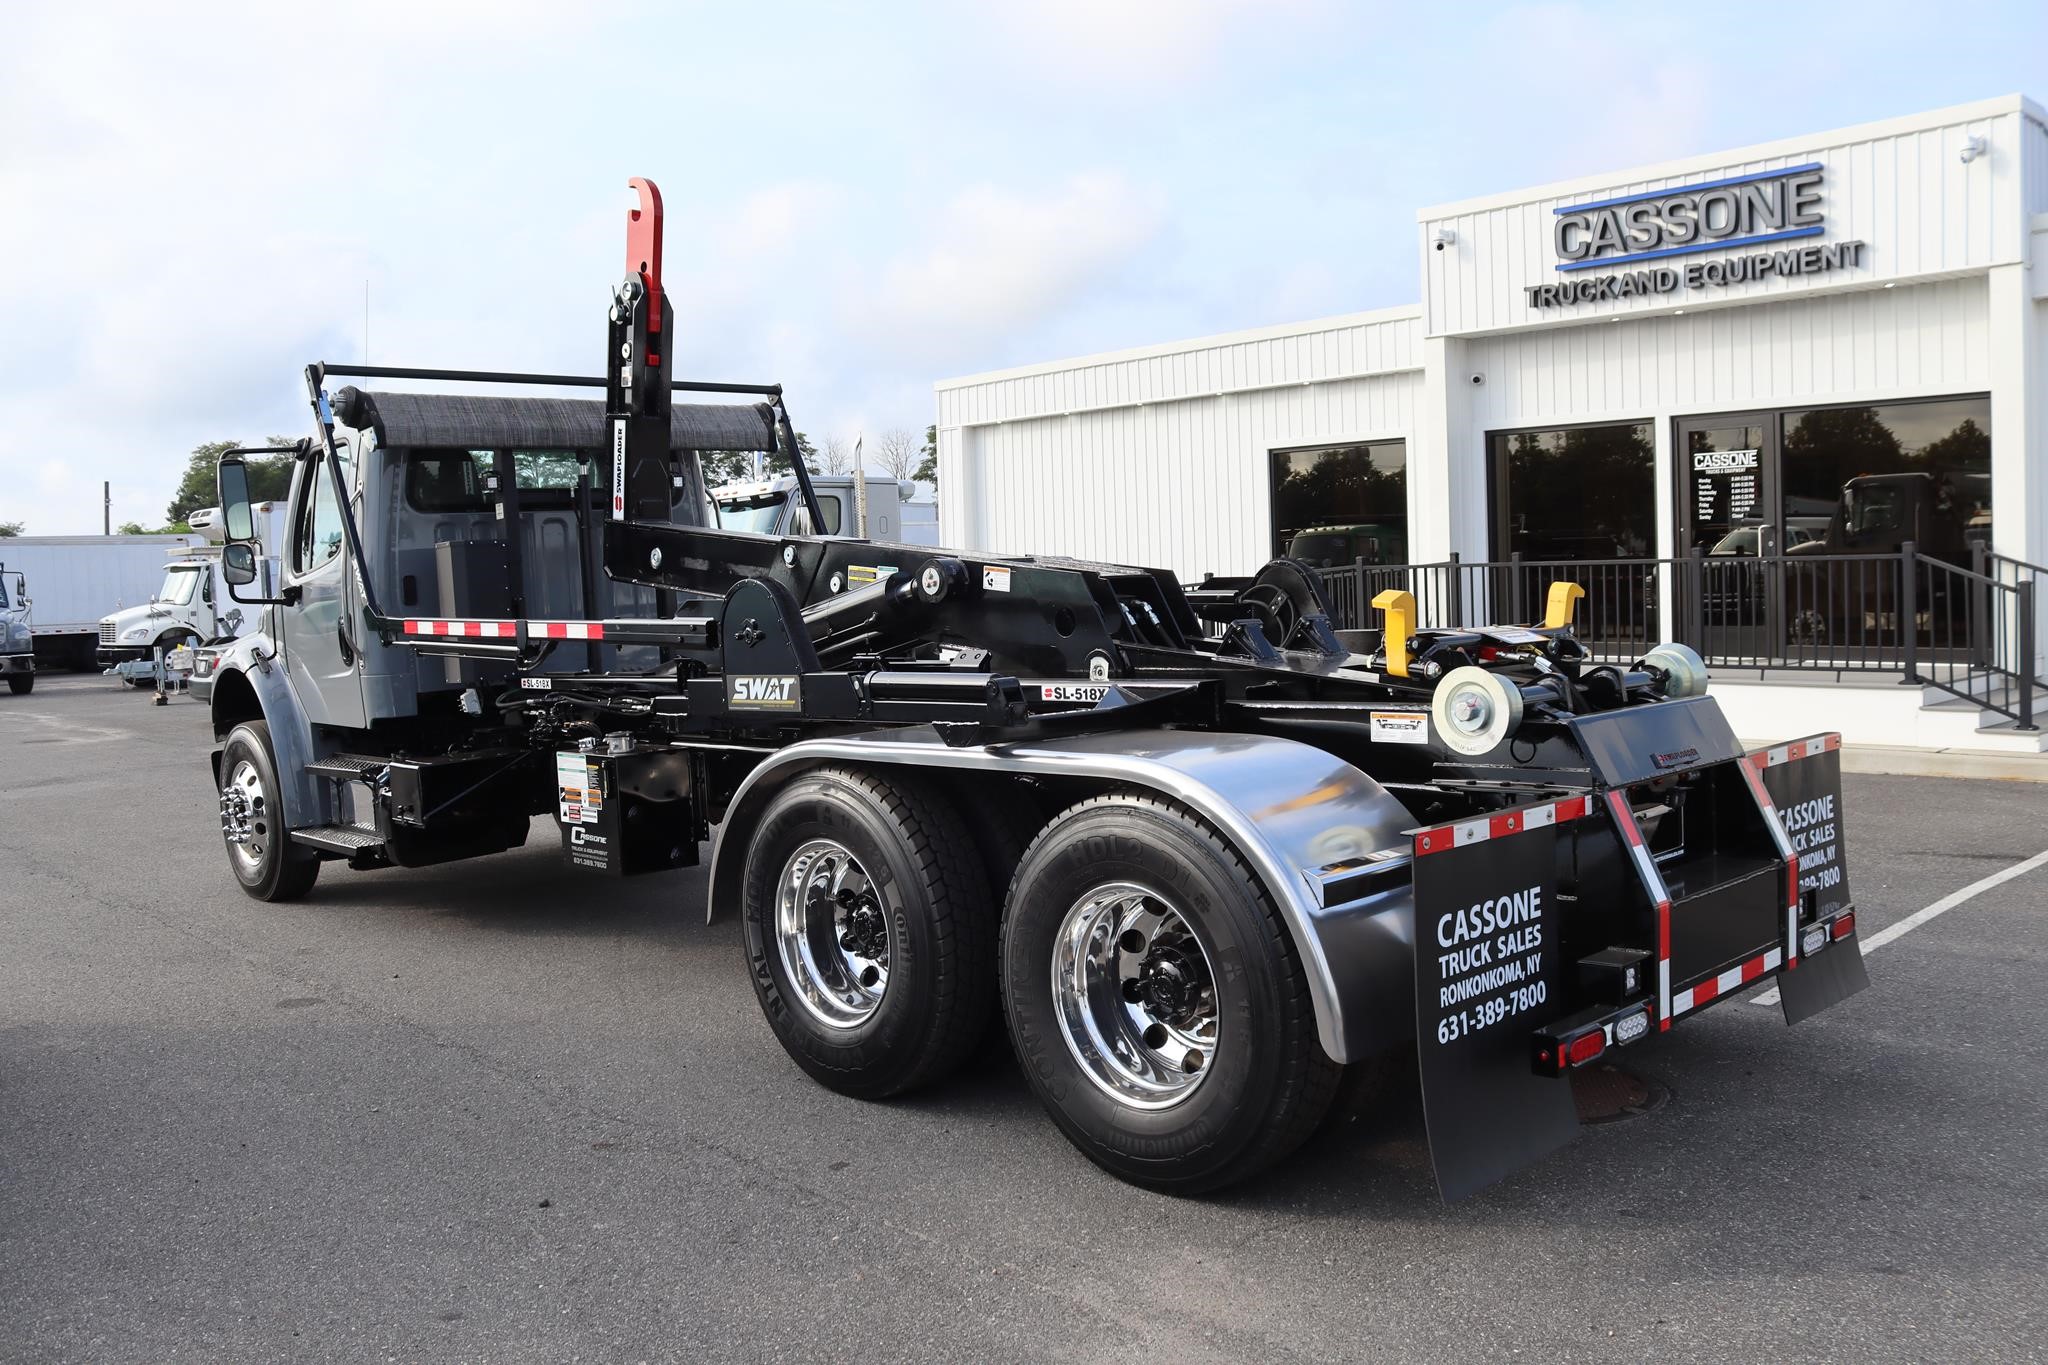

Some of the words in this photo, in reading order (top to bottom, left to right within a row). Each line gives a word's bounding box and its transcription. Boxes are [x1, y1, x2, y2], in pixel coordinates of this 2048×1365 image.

[1554, 175, 1824, 260] CASSONE
[1683, 240, 1865, 289] EQUIPMENT
[1694, 452, 1757, 467] CASSONE
[733, 678, 795, 700] SWAT
[1054, 686, 1106, 701] SL-518X
[1810, 823, 1835, 847] SALES
[1827, 844, 1836, 861] NY
[1437, 886, 1542, 948] CASSONE
[1438, 940, 1492, 979] TRUCK
[1497, 924, 1542, 959] SALES
[1440, 960, 1526, 1008] RONKONKOMA,
[1526, 952, 1542, 975] NY
[1437, 980, 1546, 1044] 631-389-7800
